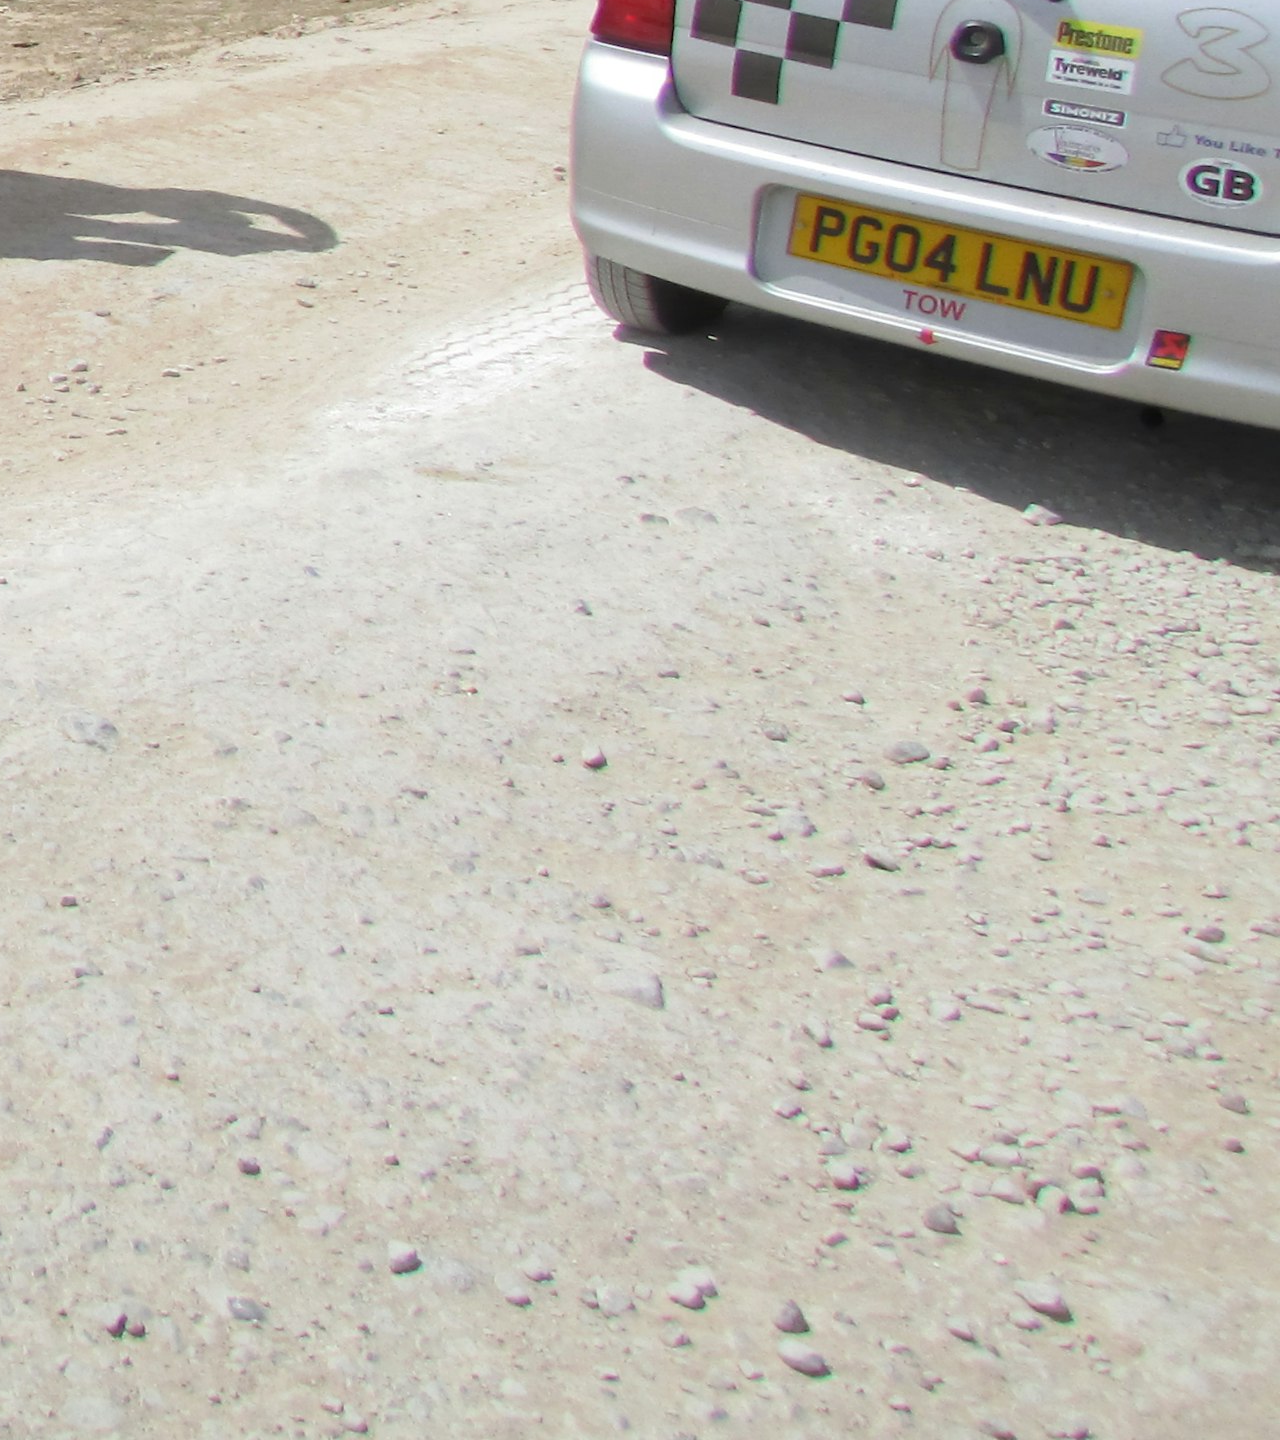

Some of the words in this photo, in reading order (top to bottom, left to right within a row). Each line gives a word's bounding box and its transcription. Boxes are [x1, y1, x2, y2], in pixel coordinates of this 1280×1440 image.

[1056, 21, 1134, 54] Prestone
[1050, 103, 1120, 123] SIMONIZ
[1194, 135, 1224, 149] You
[1229, 141, 1267, 157] Like
[1186, 165, 1254, 201] GB
[809, 205, 957, 285] PG04
[975, 242, 1100, 314] LNU
[902, 289, 967, 322] TOW
